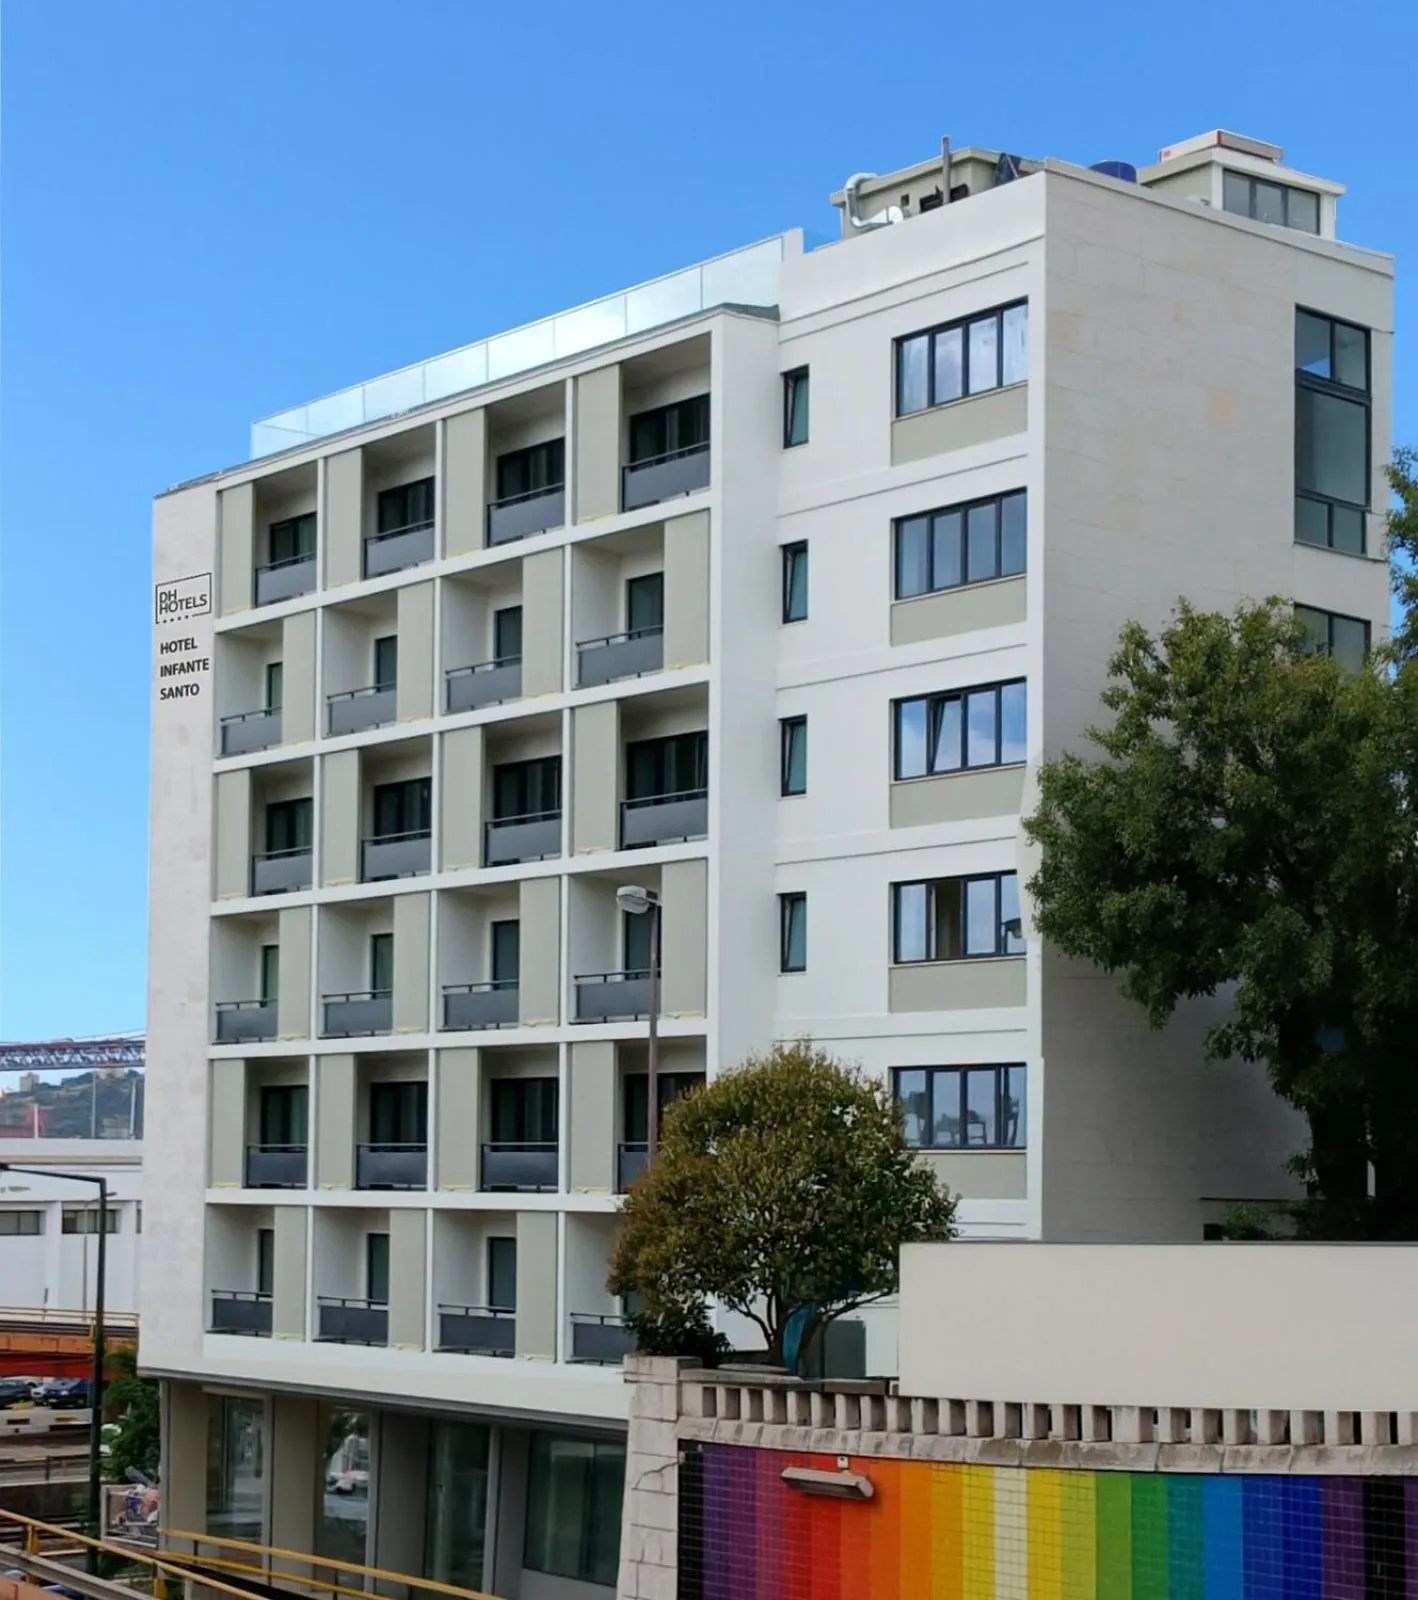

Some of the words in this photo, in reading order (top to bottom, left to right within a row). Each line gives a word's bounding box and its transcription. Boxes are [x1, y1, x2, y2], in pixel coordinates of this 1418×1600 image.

[160, 589, 177, 603] DH
[160, 594, 207, 615] HOTELS
[160, 637, 198, 655] HOTEL
[160, 658, 209, 677] INFANTE
[160, 683, 200, 700] SANTO
